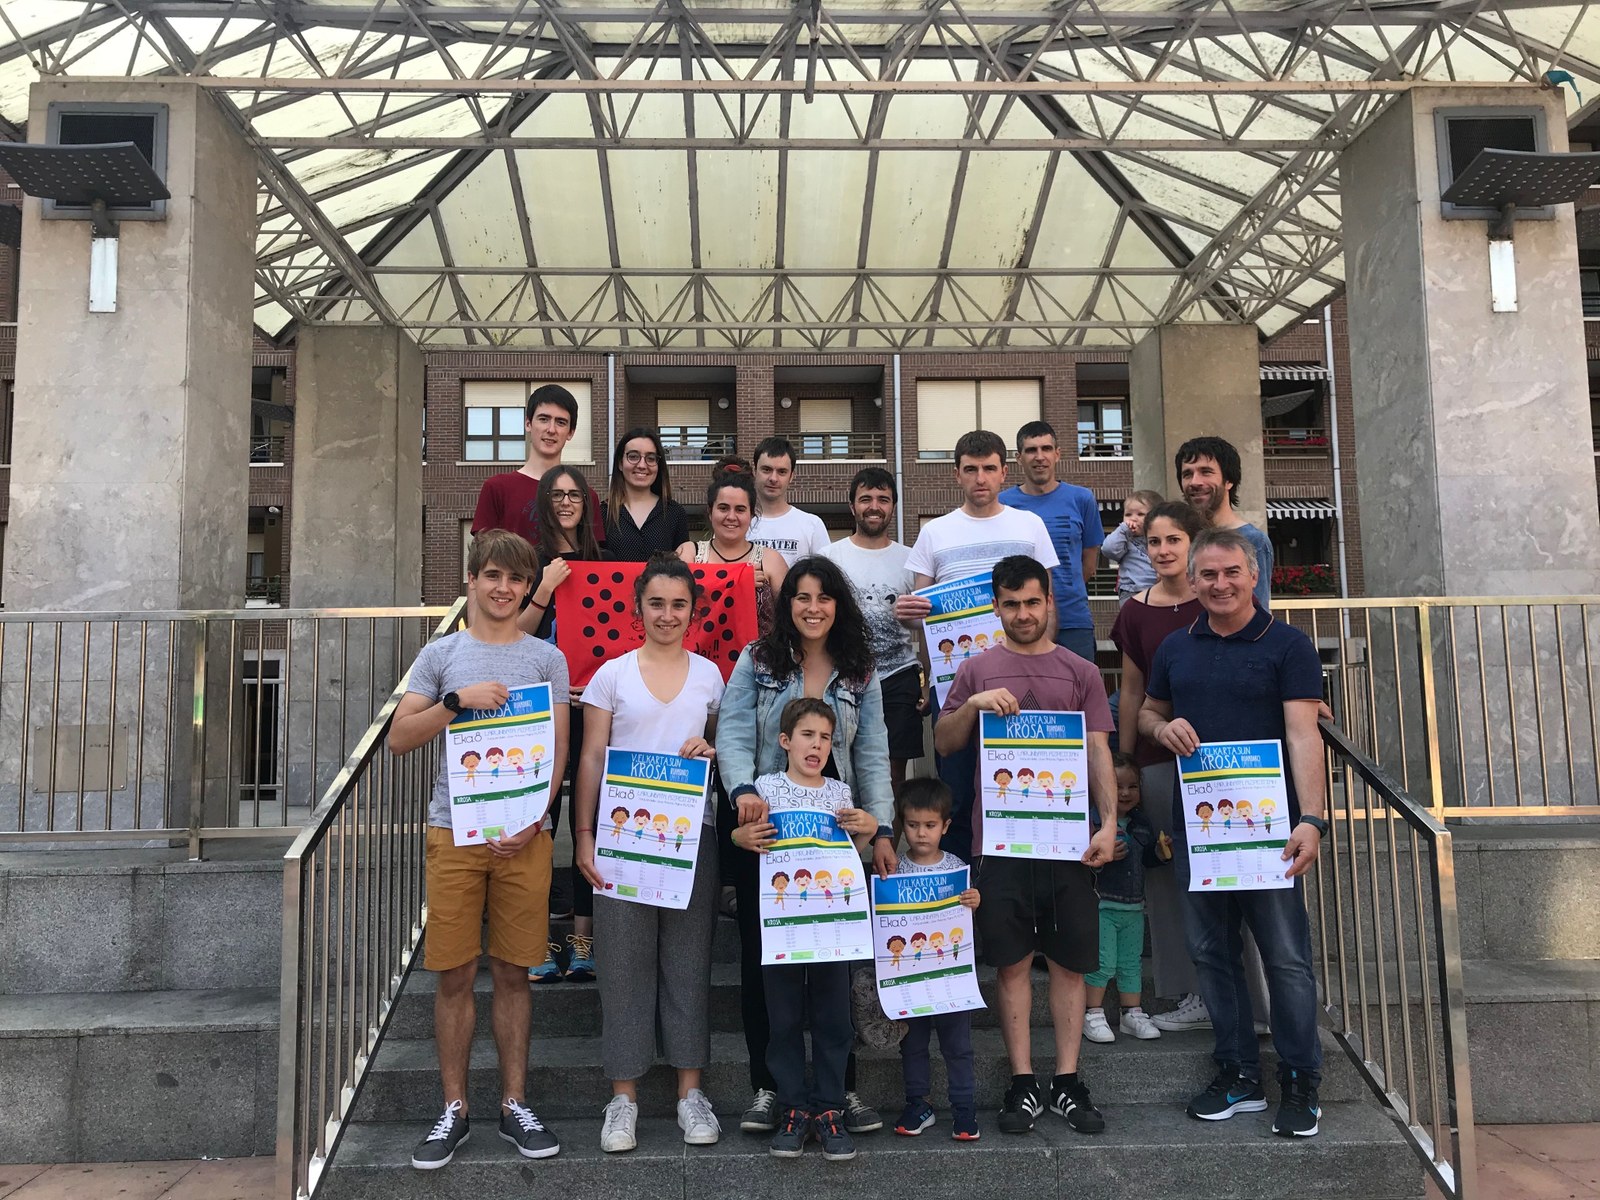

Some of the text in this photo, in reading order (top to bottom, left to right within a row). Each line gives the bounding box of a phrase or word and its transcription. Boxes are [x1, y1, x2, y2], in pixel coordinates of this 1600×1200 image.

[941, 597, 976, 614] KROSA
[1006, 723, 1046, 739] KROSA
[1200, 755, 1241, 771] KROSA
[630, 762, 668, 781] KROSA
[782, 821, 818, 839] KROSA
[898, 887, 937, 903] KROSA
